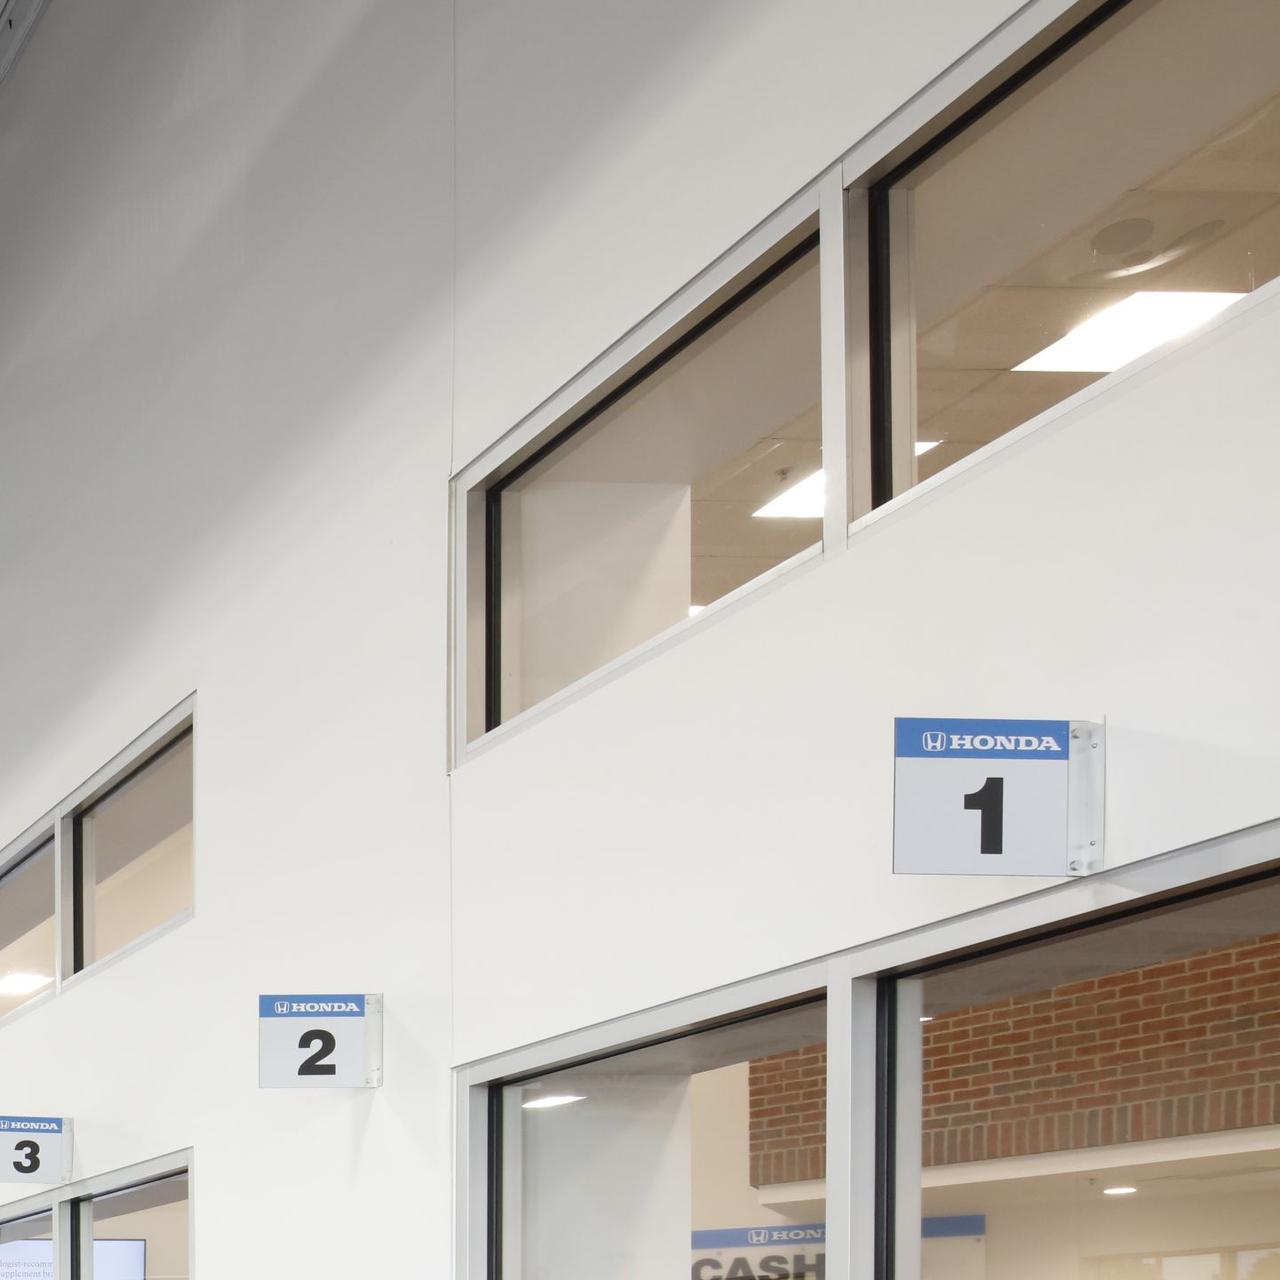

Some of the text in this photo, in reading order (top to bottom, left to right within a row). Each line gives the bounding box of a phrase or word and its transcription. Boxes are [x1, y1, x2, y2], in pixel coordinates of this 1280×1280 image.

[949, 735, 1061, 751] HONDA
[963, 776, 1004, 855] 1
[291, 1002, 360, 1013] HONDA
[297, 1028, 336, 1076] 2
[10, 1121, 60, 1130] HONDA
[12, 1139, 40, 1174] 3
[770, 1229, 826, 1241] HON
